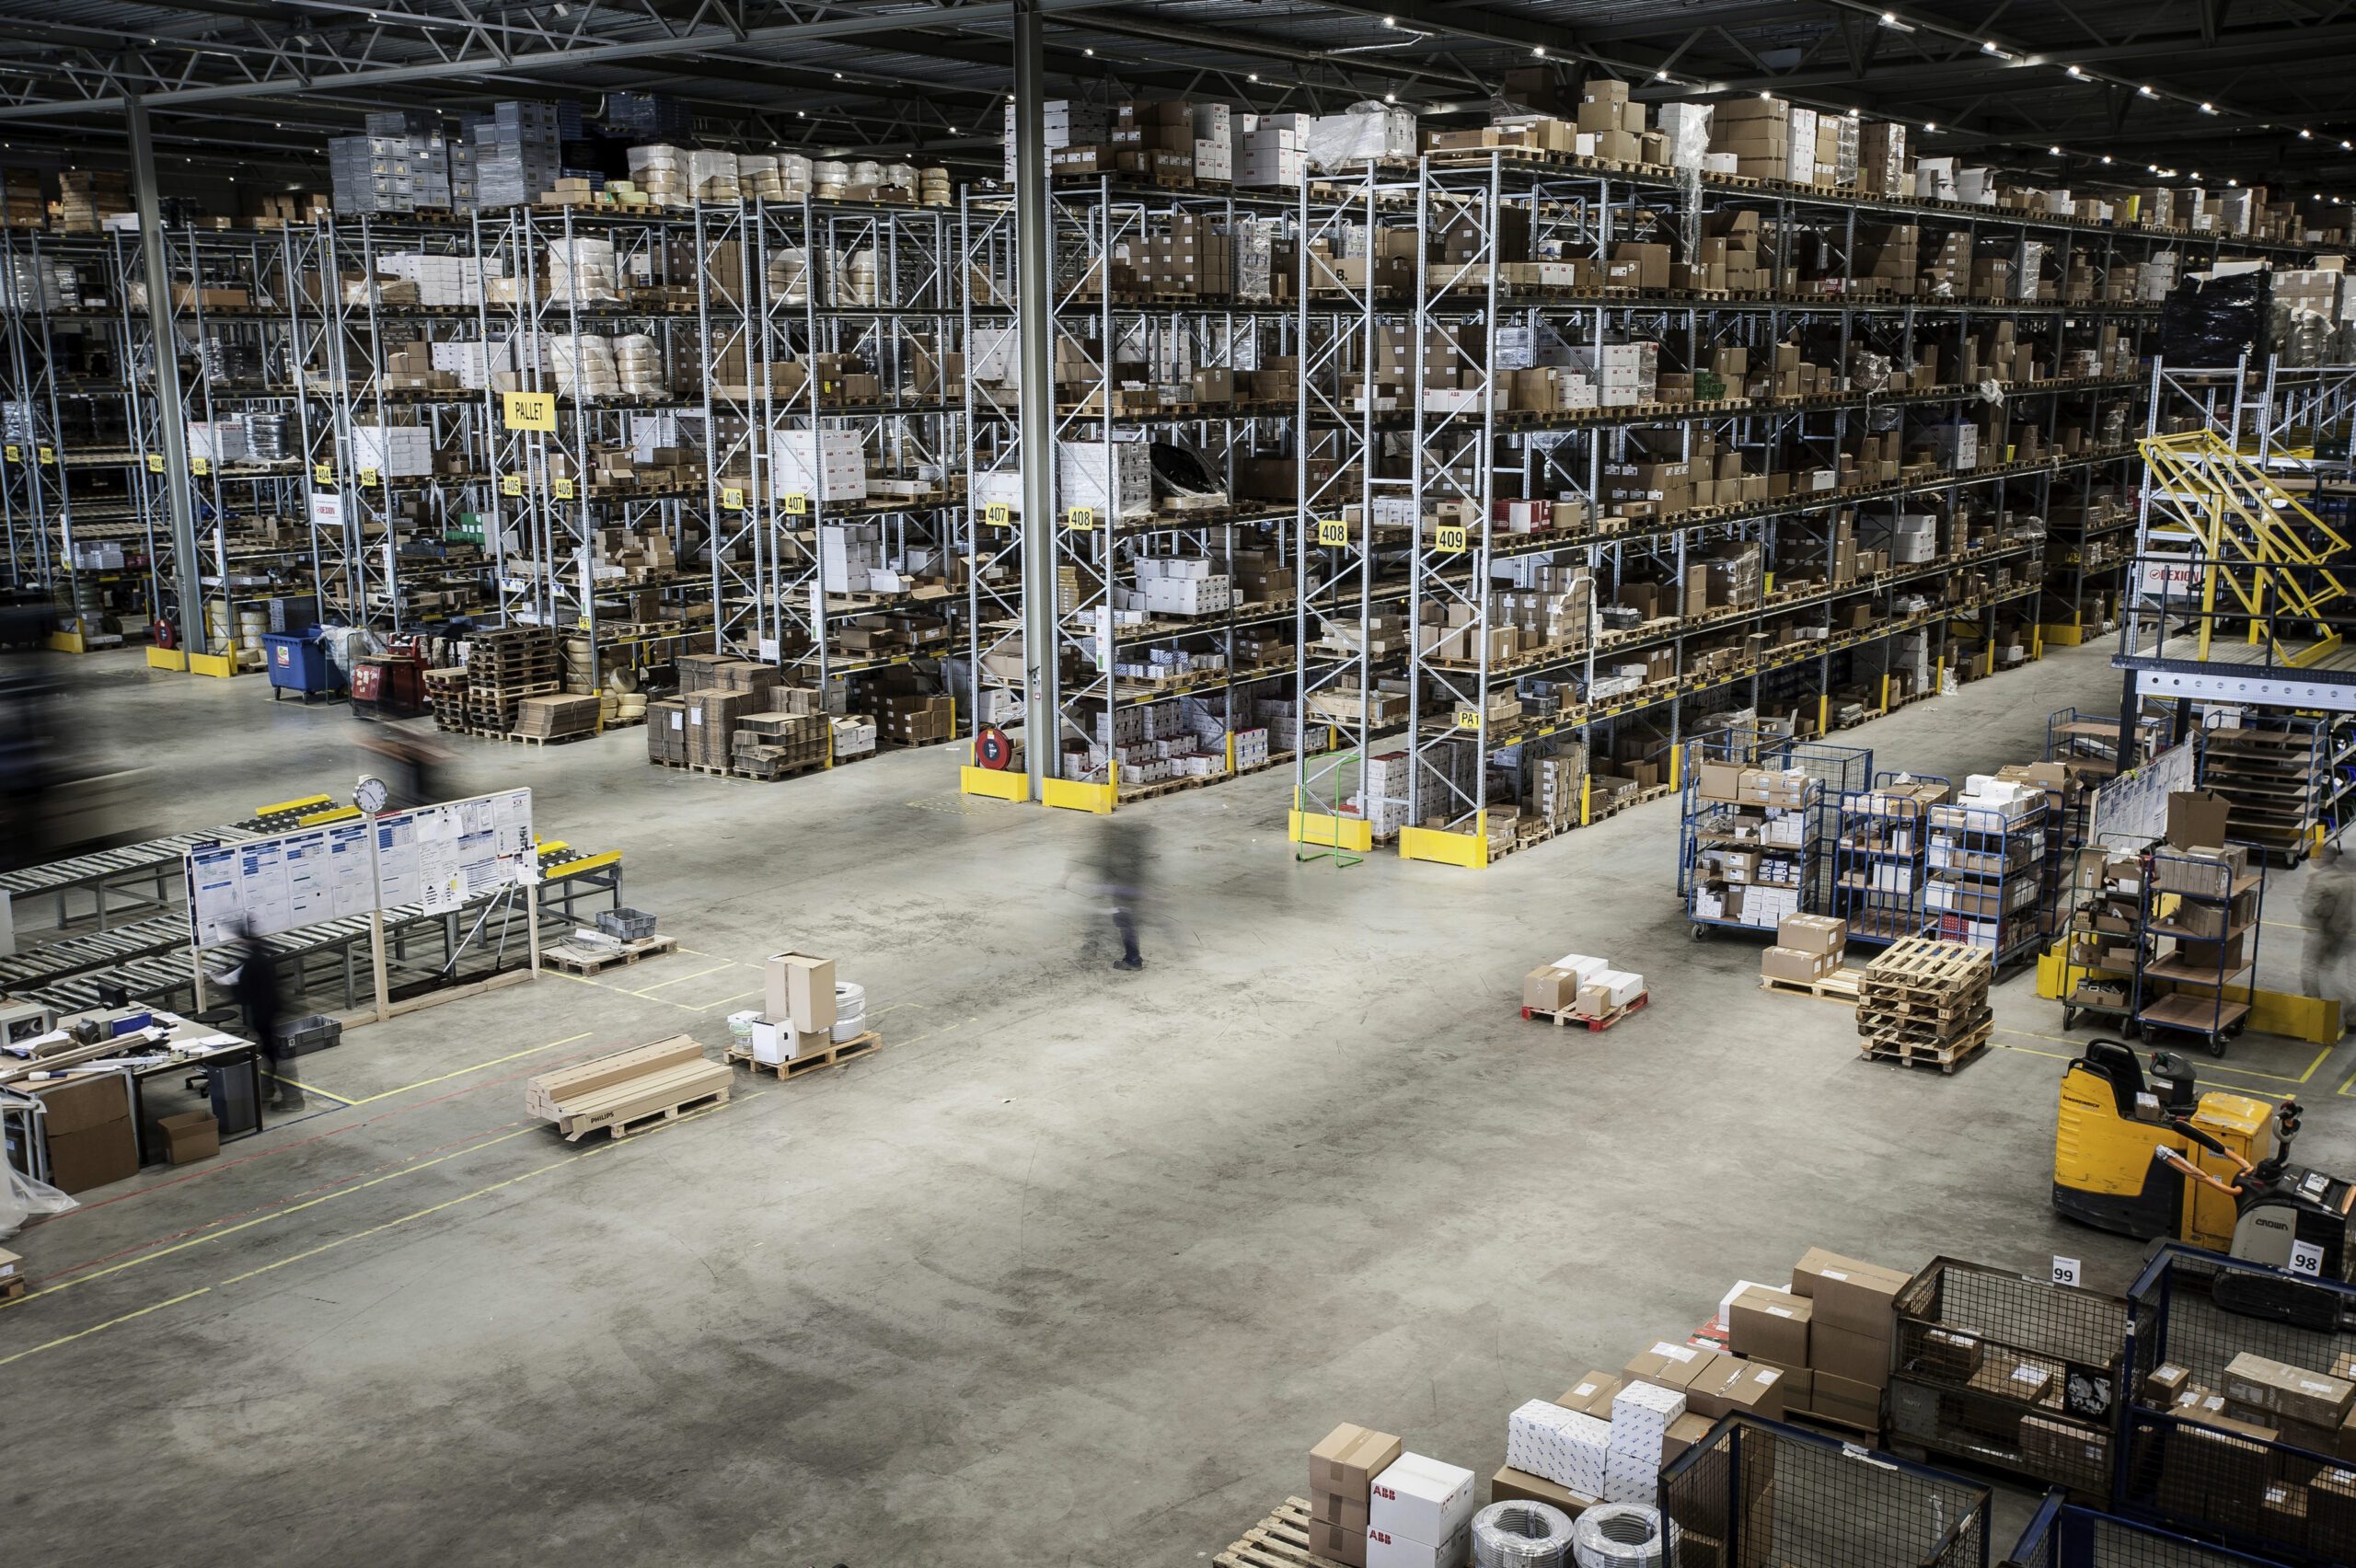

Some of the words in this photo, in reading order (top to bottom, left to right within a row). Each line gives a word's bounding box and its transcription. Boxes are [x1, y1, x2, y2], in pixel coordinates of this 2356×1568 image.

[515, 401, 543, 421] PALLET
[152, 458, 162, 469] 403
[195, 460, 205, 472] 404
[318, 467, 329, 480] 404
[363, 470, 375, 483] 405
[506, 479, 519, 492] 405
[558, 482, 571, 495] 406
[726, 491, 741, 505] 406
[789, 497, 803, 511] 407
[988, 507, 1006, 522] 407
[1071, 511, 1091, 526] 408
[1322, 525, 1345, 542] 408
[1438, 531, 1462, 548] 409
[1461, 713, 1479, 725] PA1
[591, 1111, 614, 1124] PHILIPS
[2255, 1218, 2289, 1231] CROWN
[2294, 1254, 2317, 1271] 98
[2054, 1267, 2073, 1282] 99
[1372, 1485, 1396, 1501] ABB
[1369, 1529, 1392, 1545] ABB
